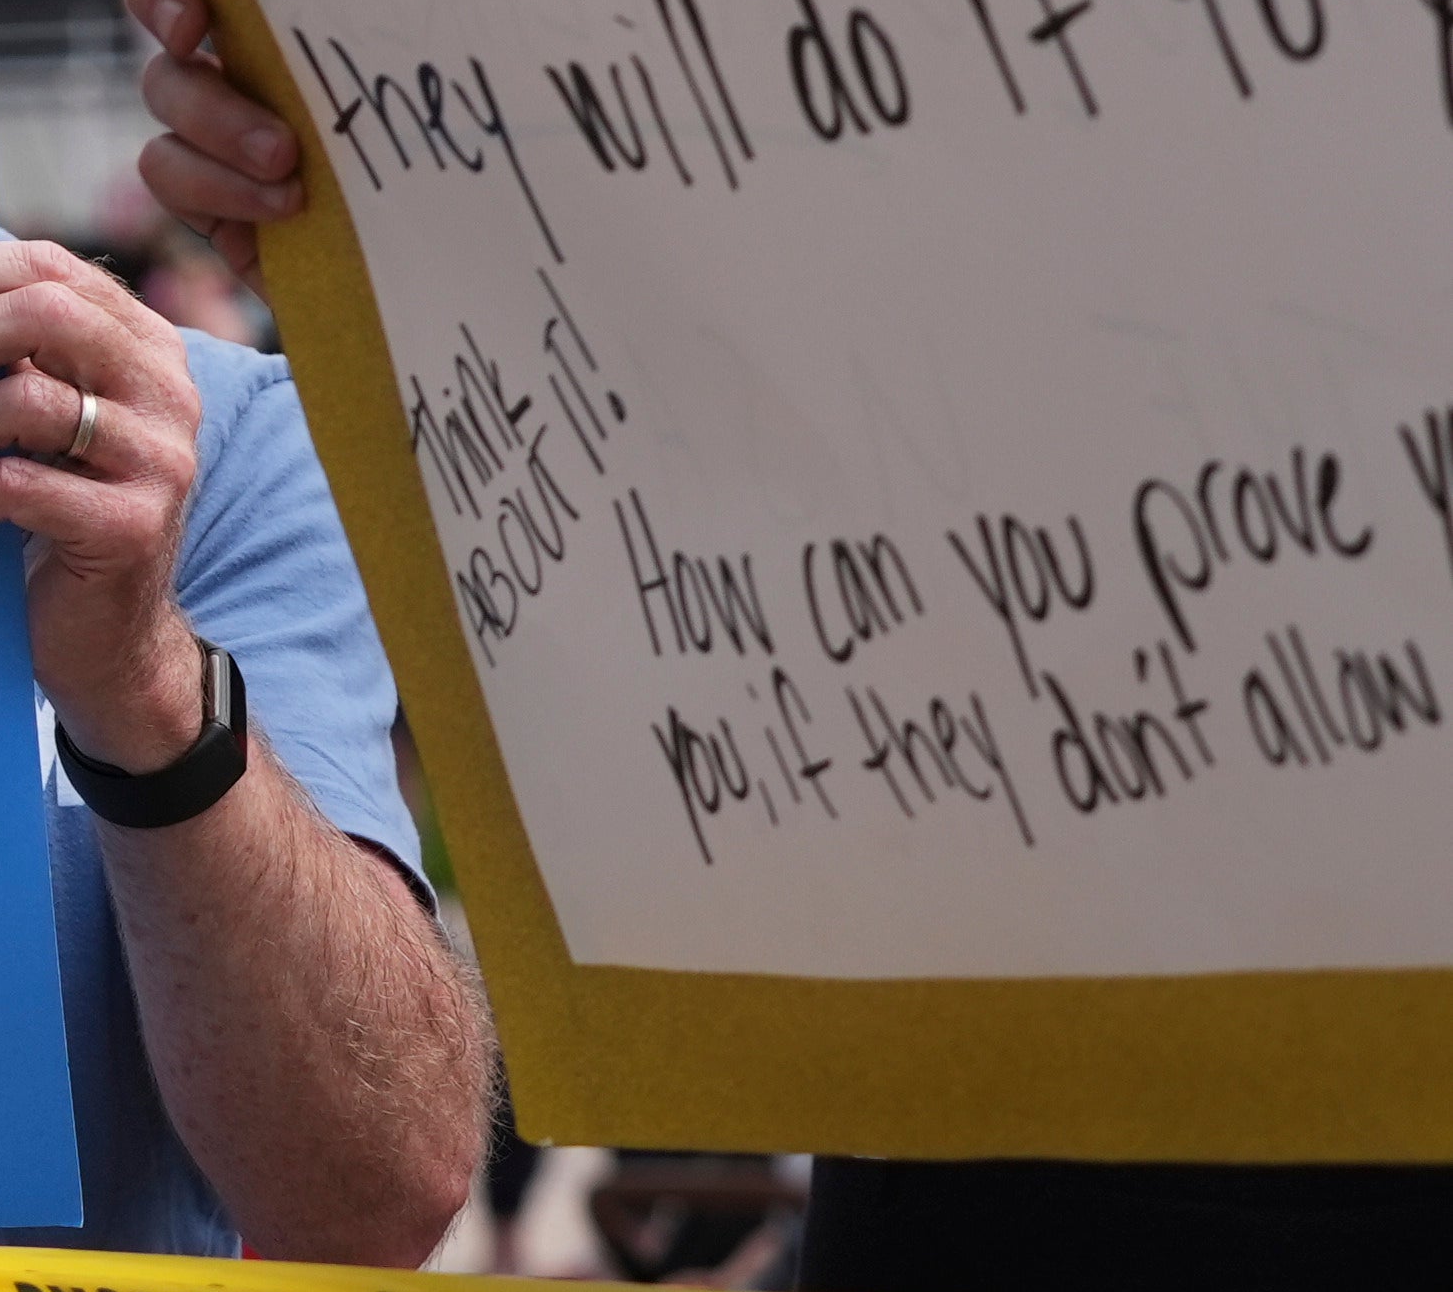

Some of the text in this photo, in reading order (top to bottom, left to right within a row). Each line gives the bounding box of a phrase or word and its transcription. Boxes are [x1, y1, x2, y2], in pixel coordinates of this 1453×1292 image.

[292, 26, 564, 263] they
[455, 422, 580, 669] ABOUT
[612, 486, 775, 657] How
[803, 532, 925, 664] can
[945, 513, 1094, 702] you
[1132, 444, 1374, 655] prove
[845, 684, 1037, 849] they
[1041, 638, 1216, 814] don't
[1244, 623, 1442, 768] allow
